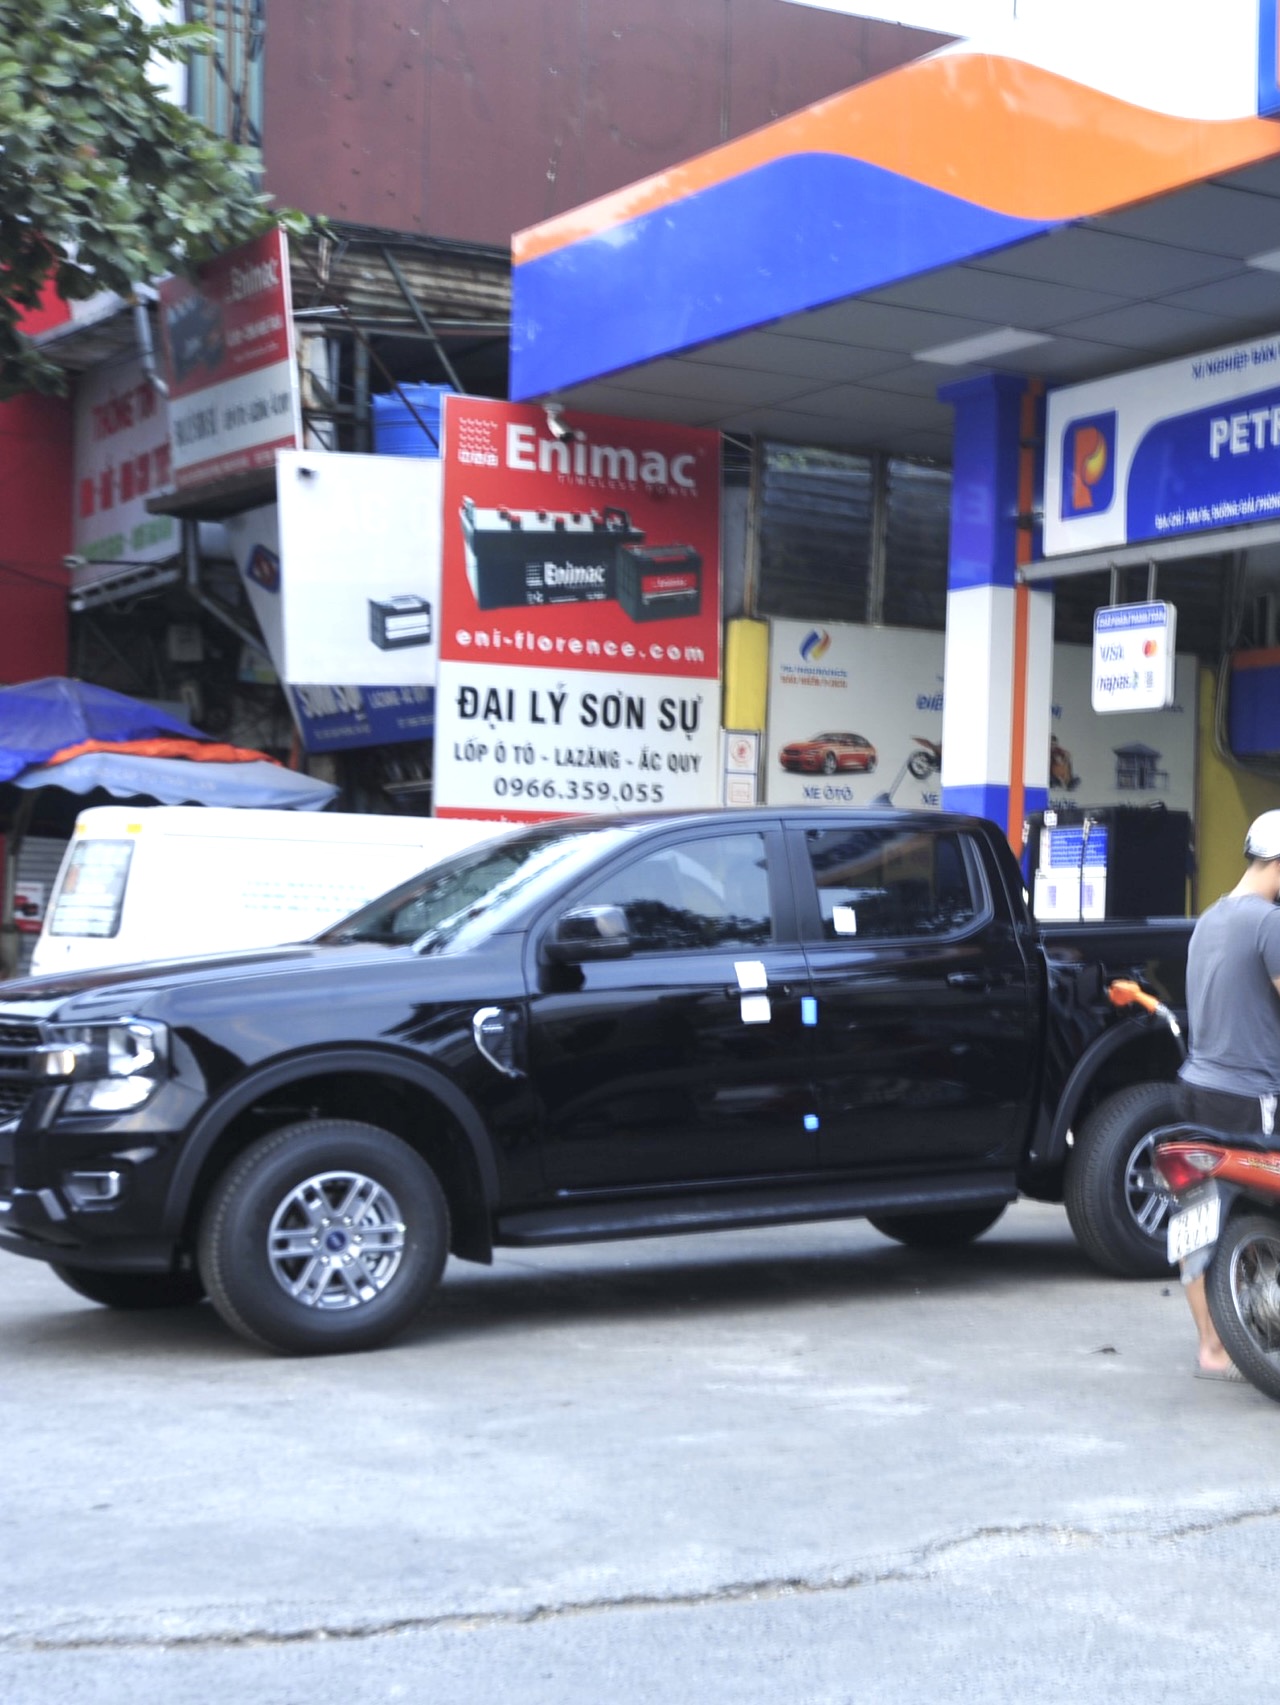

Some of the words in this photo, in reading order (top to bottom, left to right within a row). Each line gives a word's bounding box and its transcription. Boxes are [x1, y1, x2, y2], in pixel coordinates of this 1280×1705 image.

[506, 423, 697, 488] Enimac
[543, 560, 606, 587] Enimac
[455, 627, 705, 662] eni-florence.com
[1099, 643, 1125, 663] VISA
[456, 684, 516, 730] ĐẠI
[580, 688, 646, 731] SƠN
[453, 735, 490, 764] LỐP
[667, 752, 703, 774] QUY
[494, 777, 666, 804] 0966.359.055
[802, 785, 822, 800] XE
